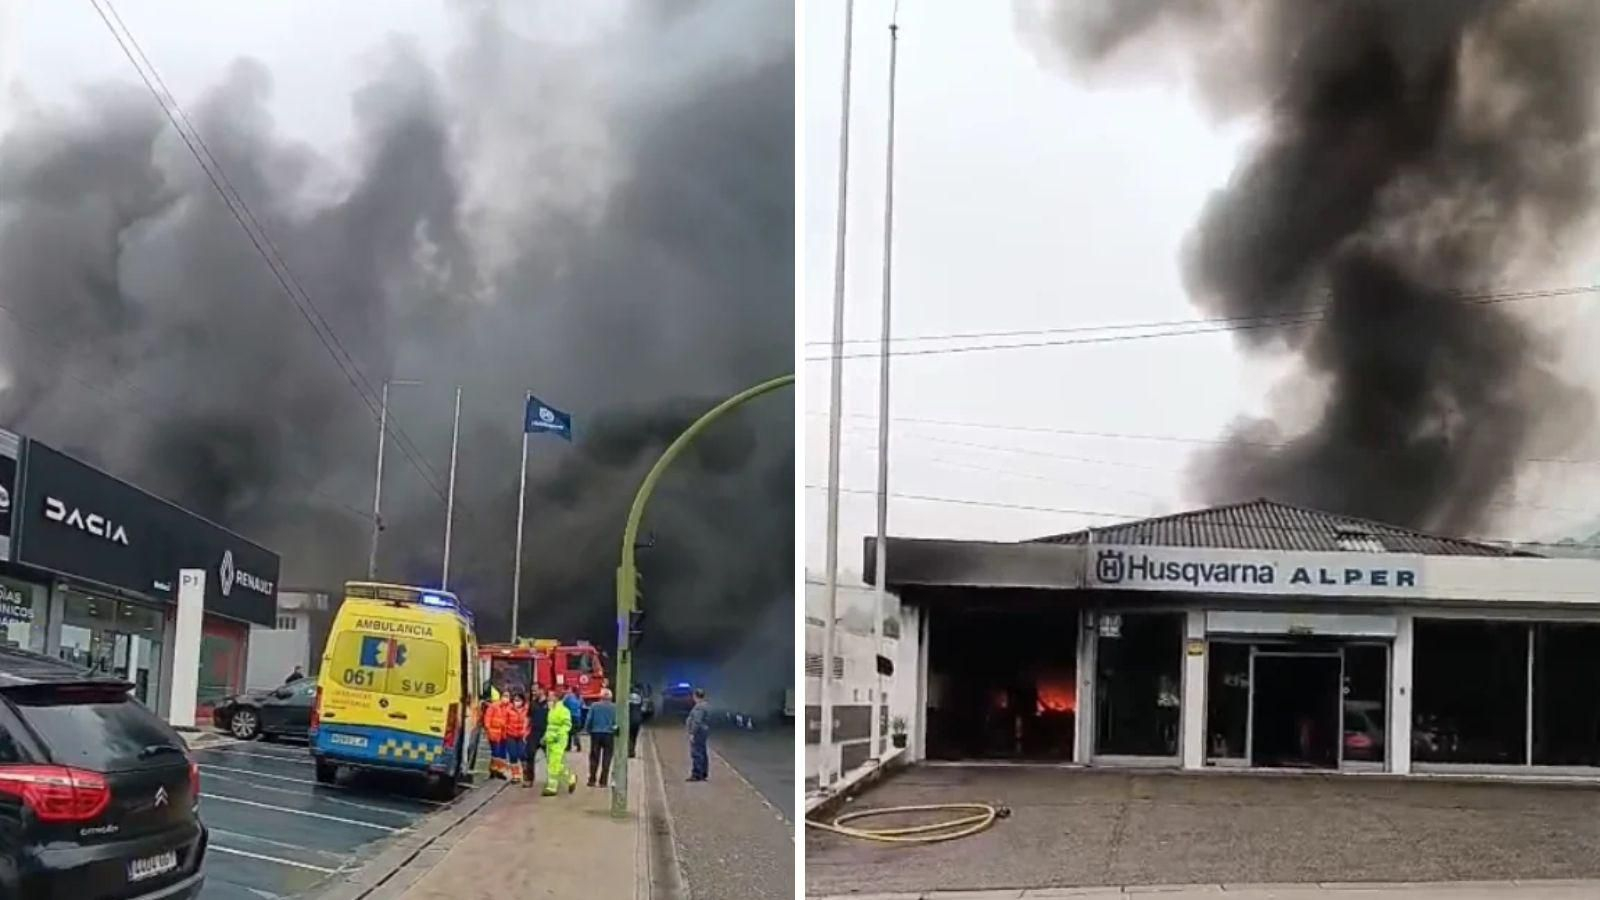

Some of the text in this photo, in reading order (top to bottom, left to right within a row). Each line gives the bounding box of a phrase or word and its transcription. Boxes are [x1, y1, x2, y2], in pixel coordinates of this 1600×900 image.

[45, 496, 129, 545] DACIA
[182, 575, 199, 586] P1
[1127, 554, 1415, 587] Husqvarna ALPER
[235, 570, 274, 596] RENAULT
[355, 618, 433, 637] AMBULANCIA
[343, 668, 375, 687] 061
